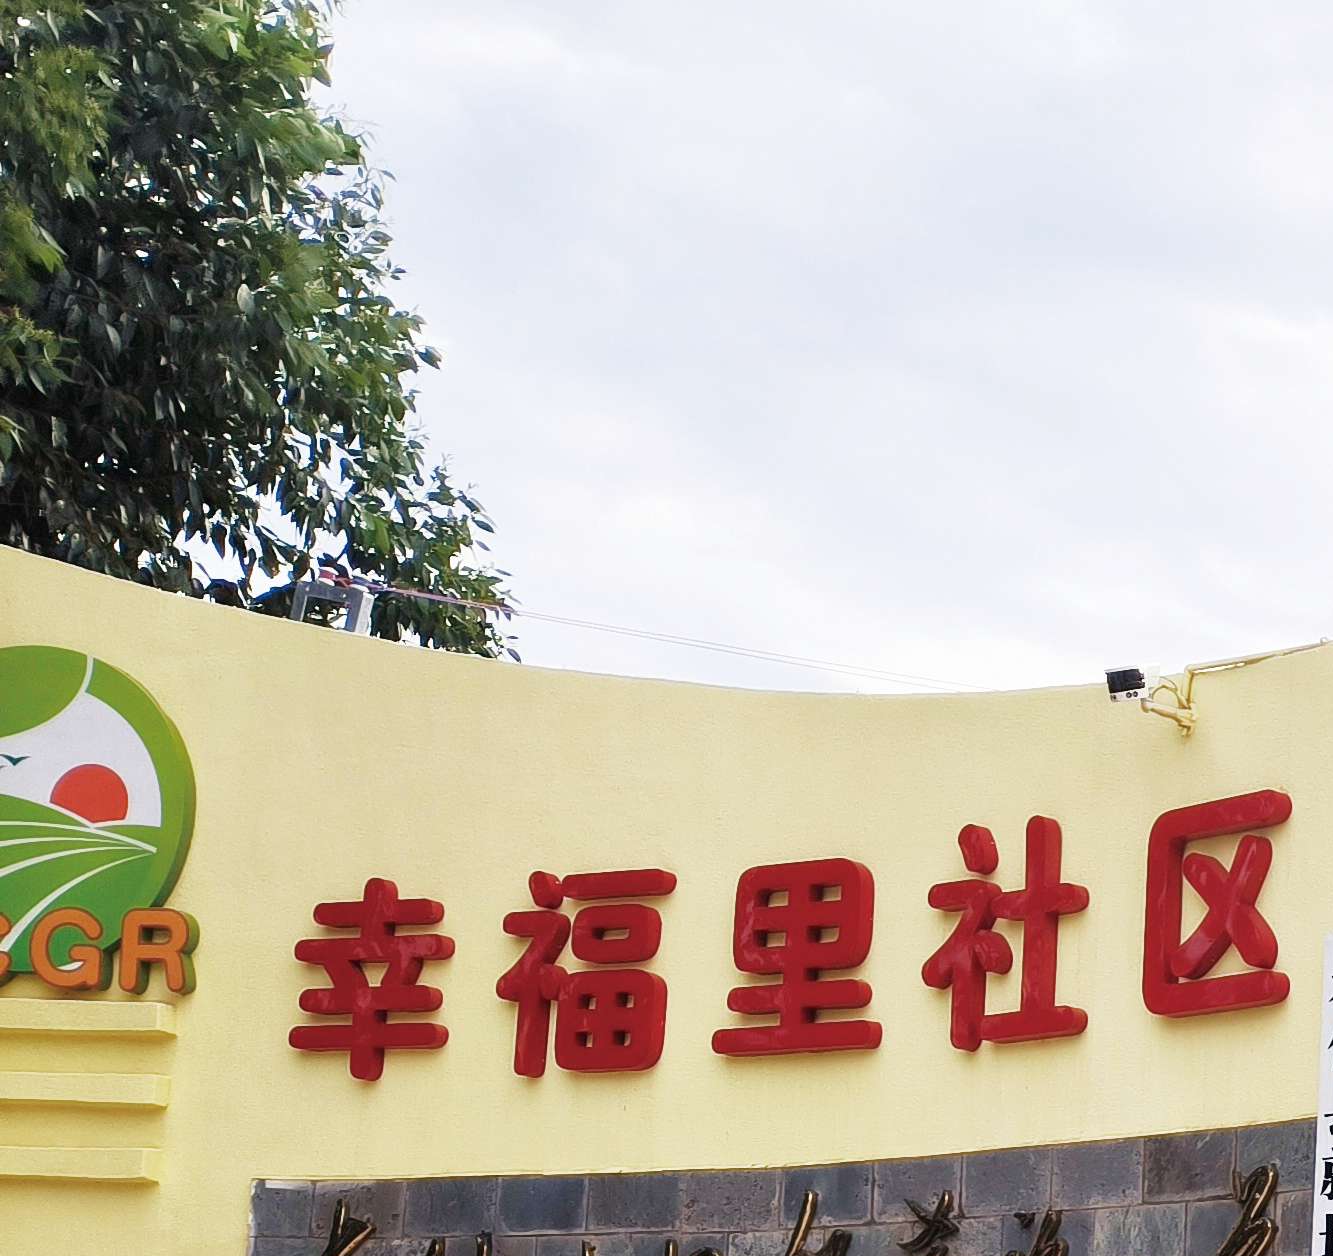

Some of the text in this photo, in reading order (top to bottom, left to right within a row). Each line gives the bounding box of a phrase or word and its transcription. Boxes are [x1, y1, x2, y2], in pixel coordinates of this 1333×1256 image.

[0, 905, 200, 995] GR
[289, 789, 1292, 1083] 幸福里社区
